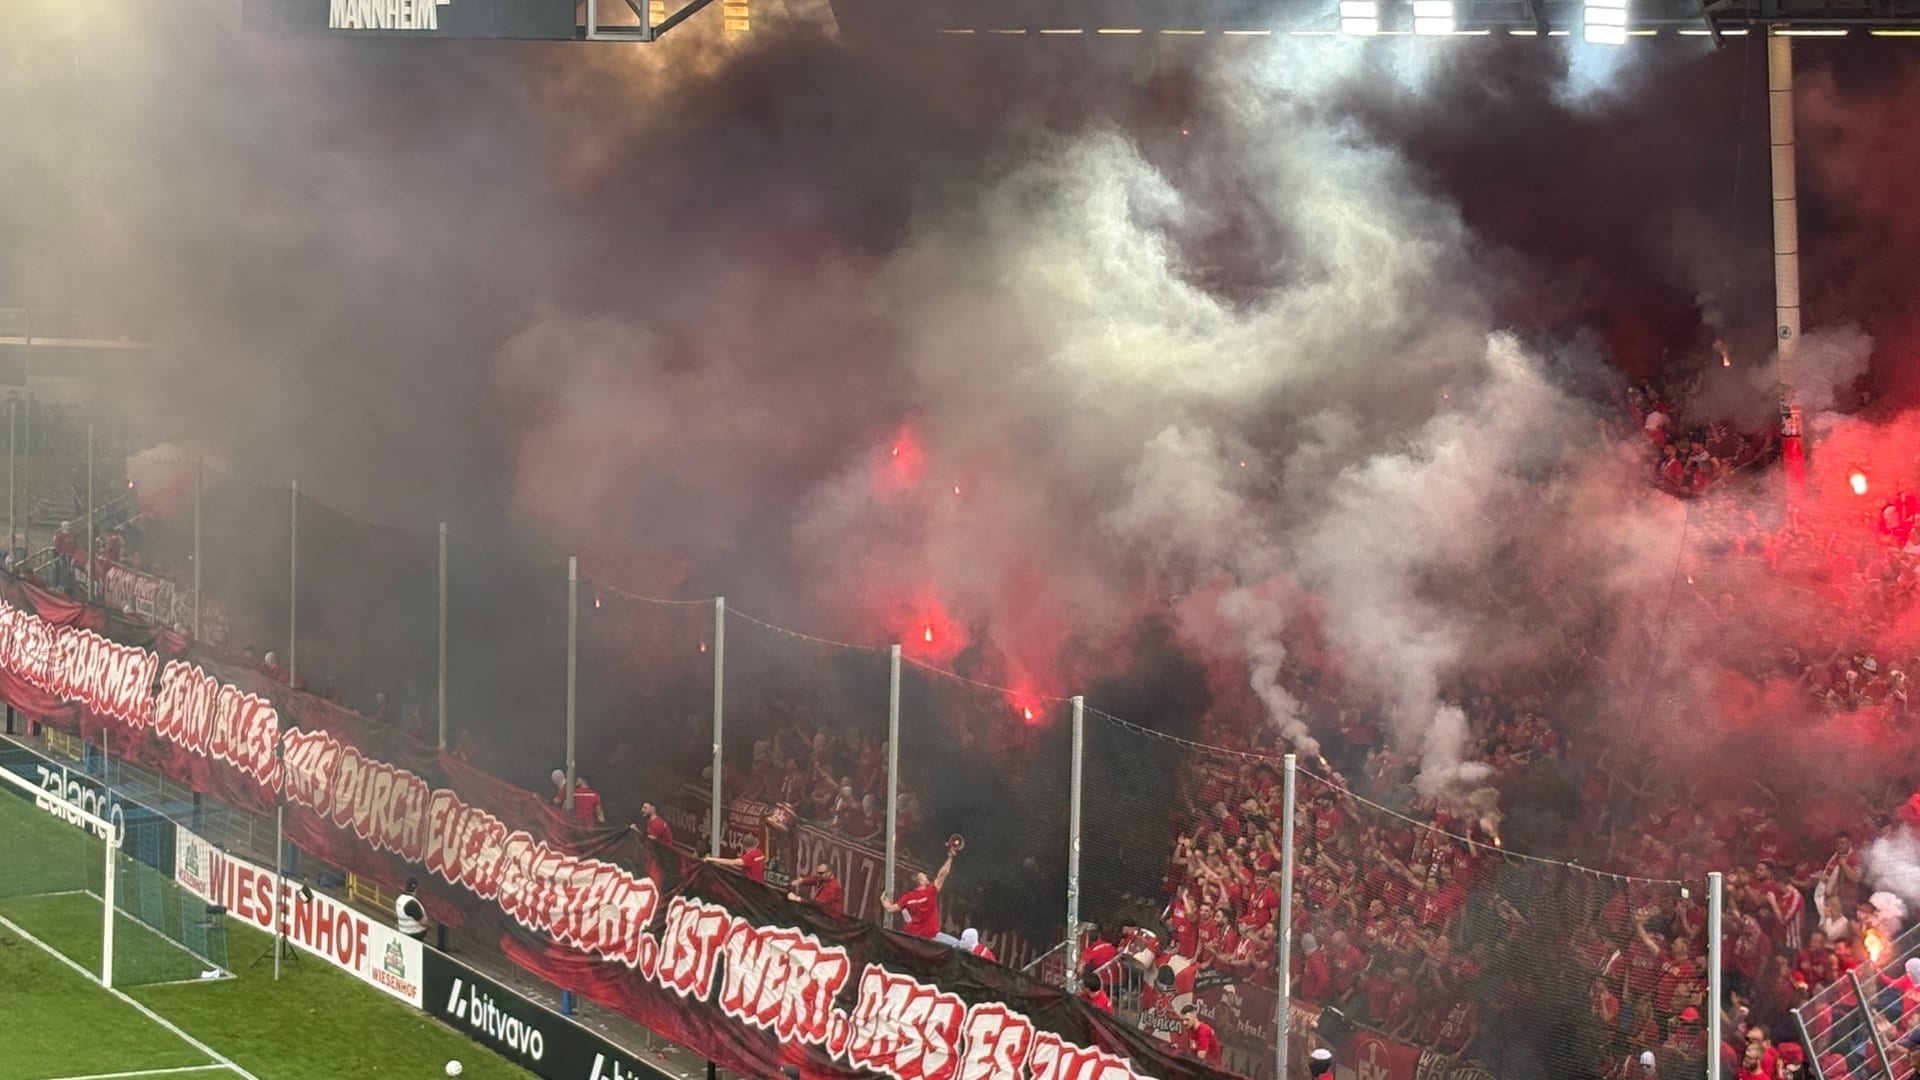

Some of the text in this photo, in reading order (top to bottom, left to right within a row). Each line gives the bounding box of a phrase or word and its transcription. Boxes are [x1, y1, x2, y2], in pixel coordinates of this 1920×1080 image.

[328, 0, 438, 30] MANNHEIM
[155, 659, 218, 757] DENN
[331, 746, 430, 863] DURCH
[424, 789, 507, 899] EUCH
[658, 896, 731, 1001] IST
[850, 963, 967, 1080] DASS
[957, 1002, 1035, 1080] ES
[209, 850, 369, 972] WIESENHOF
[371, 966, 418, 999] WIESENHOF
[470, 984, 544, 1060] bitvavo
